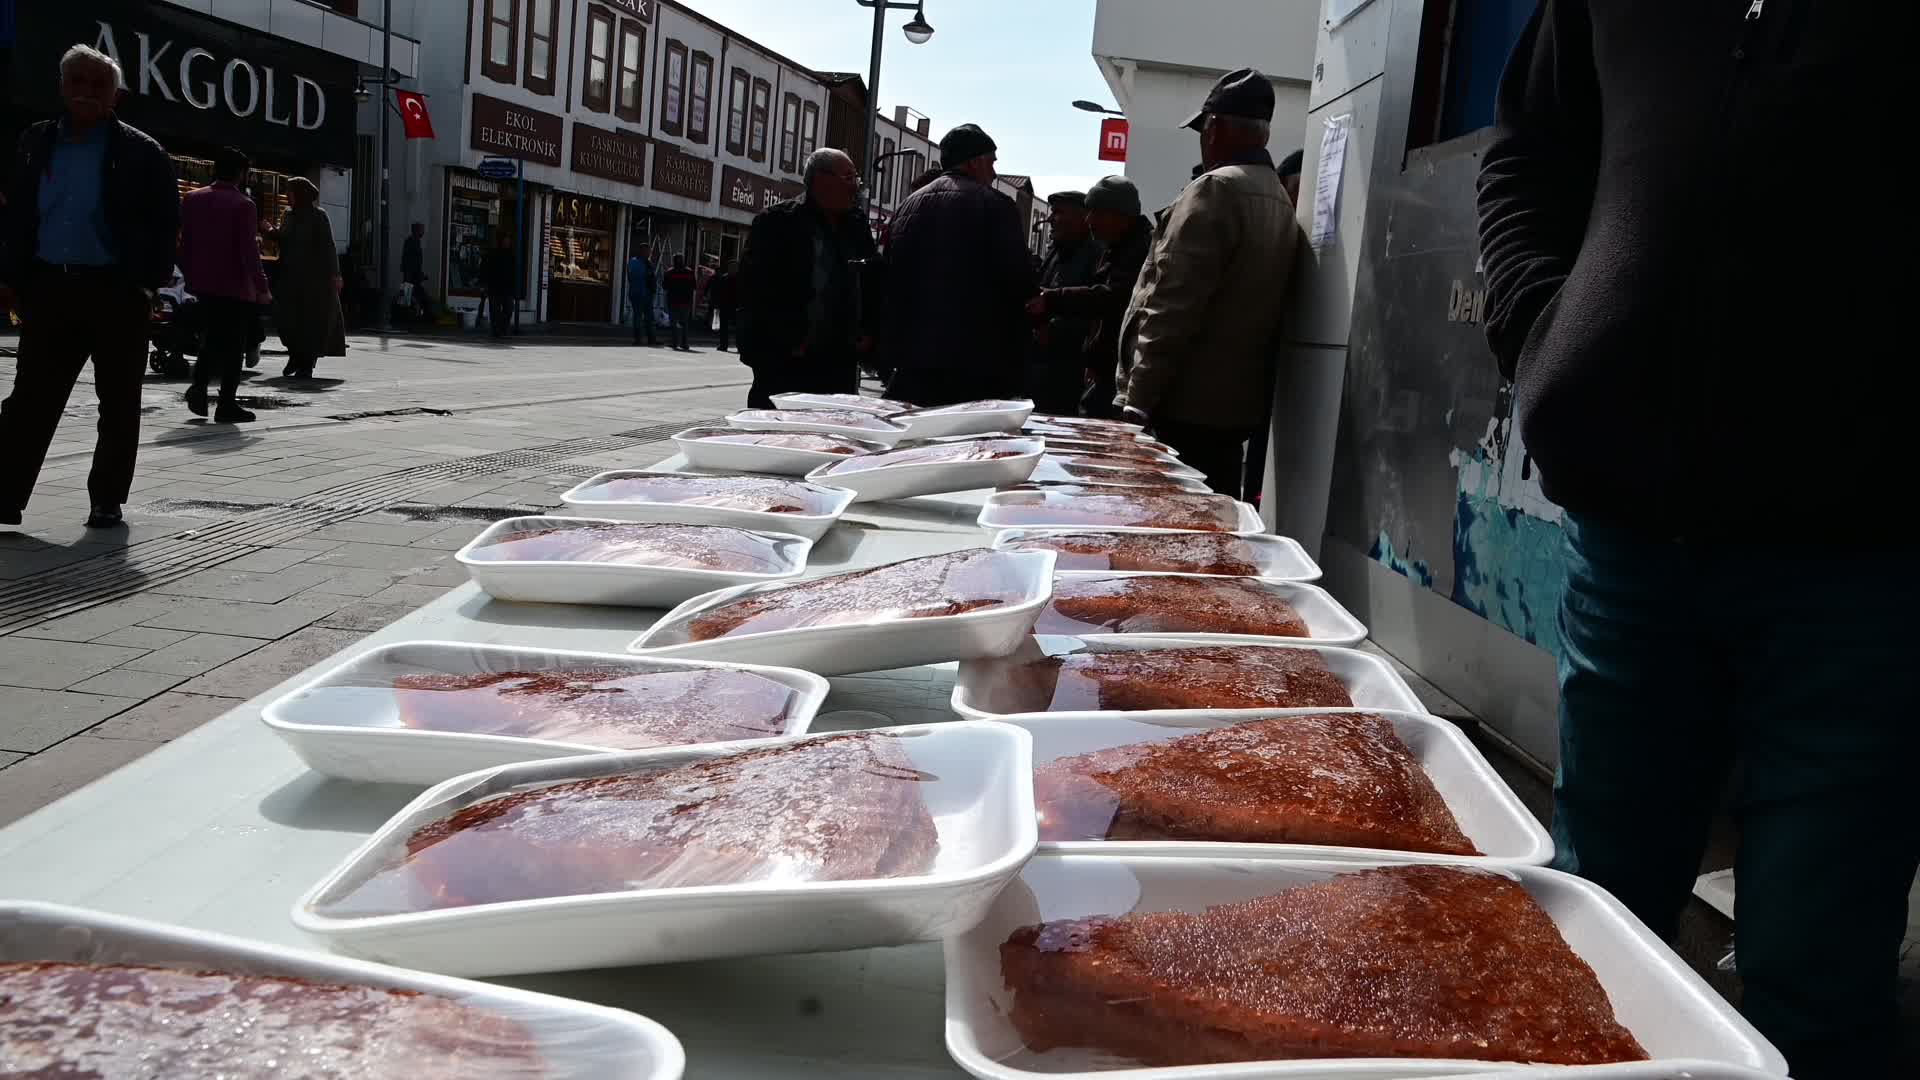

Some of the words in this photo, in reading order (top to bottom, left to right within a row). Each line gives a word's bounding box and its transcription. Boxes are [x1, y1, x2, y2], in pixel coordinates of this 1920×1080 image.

[95, 20, 327, 131] AKGOLD
[505, 110, 537, 133] EKOL
[481, 127, 557, 159] ELEKTRONİK
